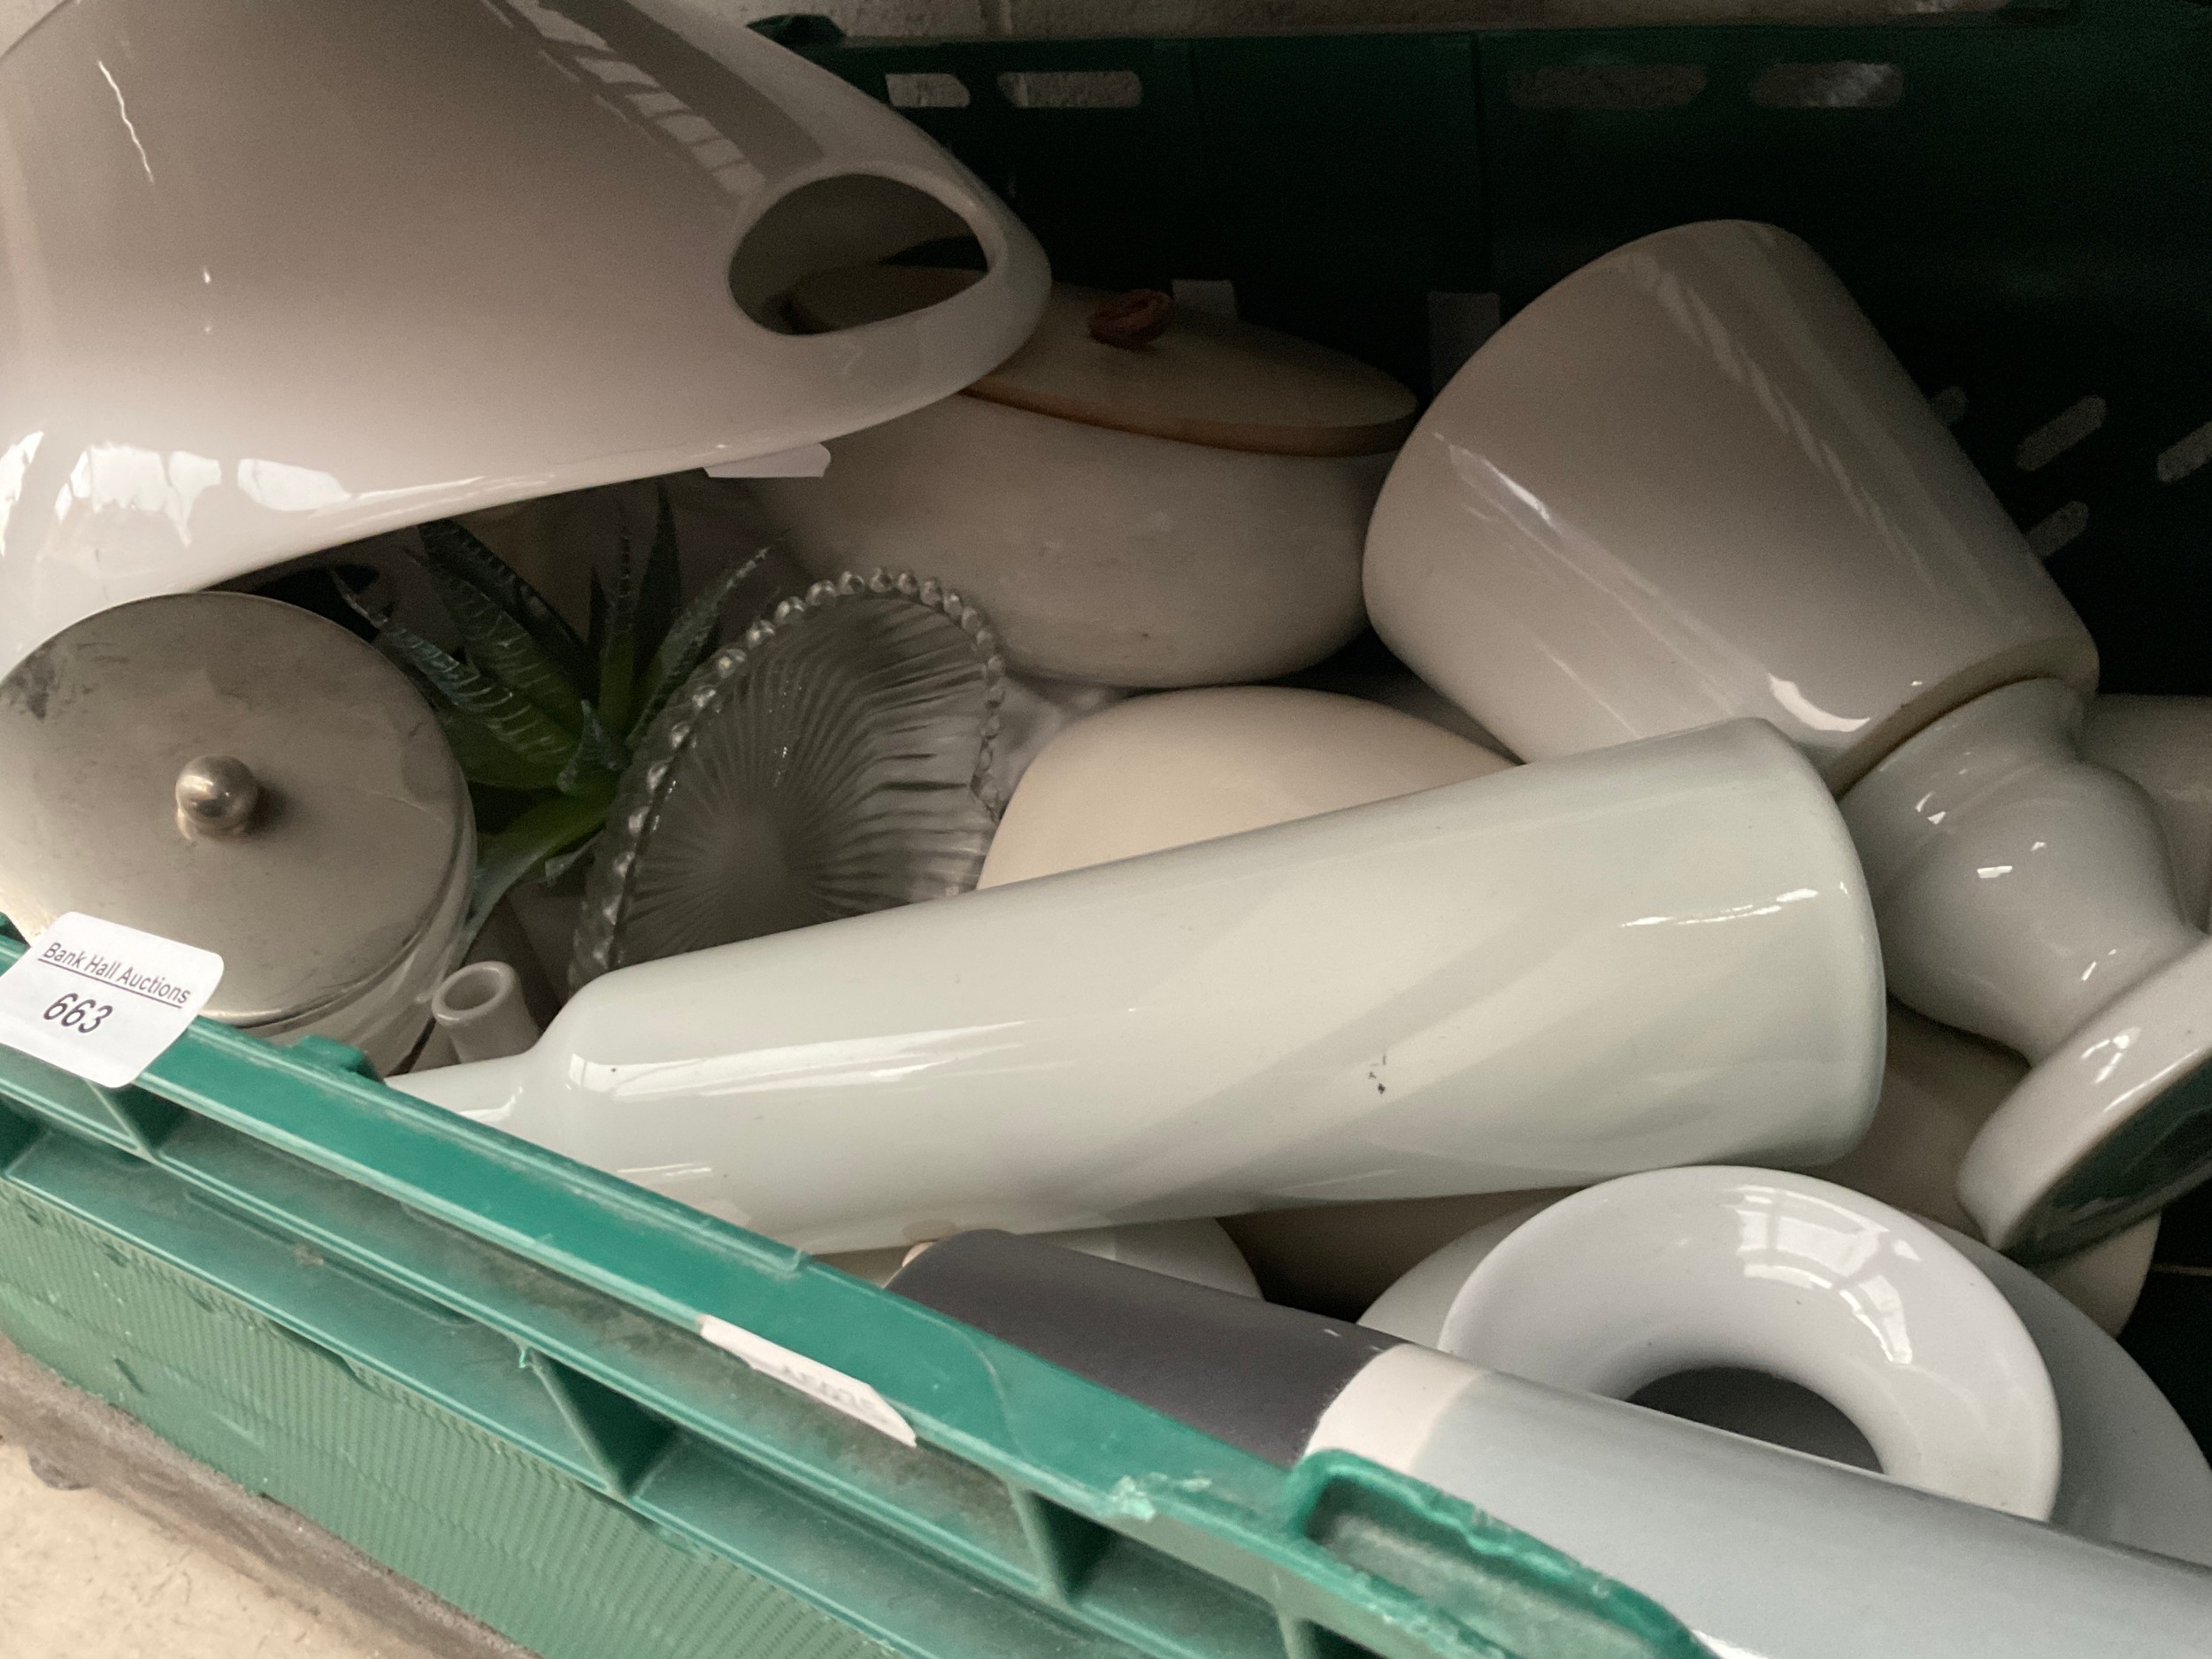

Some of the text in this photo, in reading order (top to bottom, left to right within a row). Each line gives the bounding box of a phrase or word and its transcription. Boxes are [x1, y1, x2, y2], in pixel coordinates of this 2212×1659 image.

[43, 941, 191, 1004] Bank Hall Auctions
[42, 992, 113, 1033] 663
